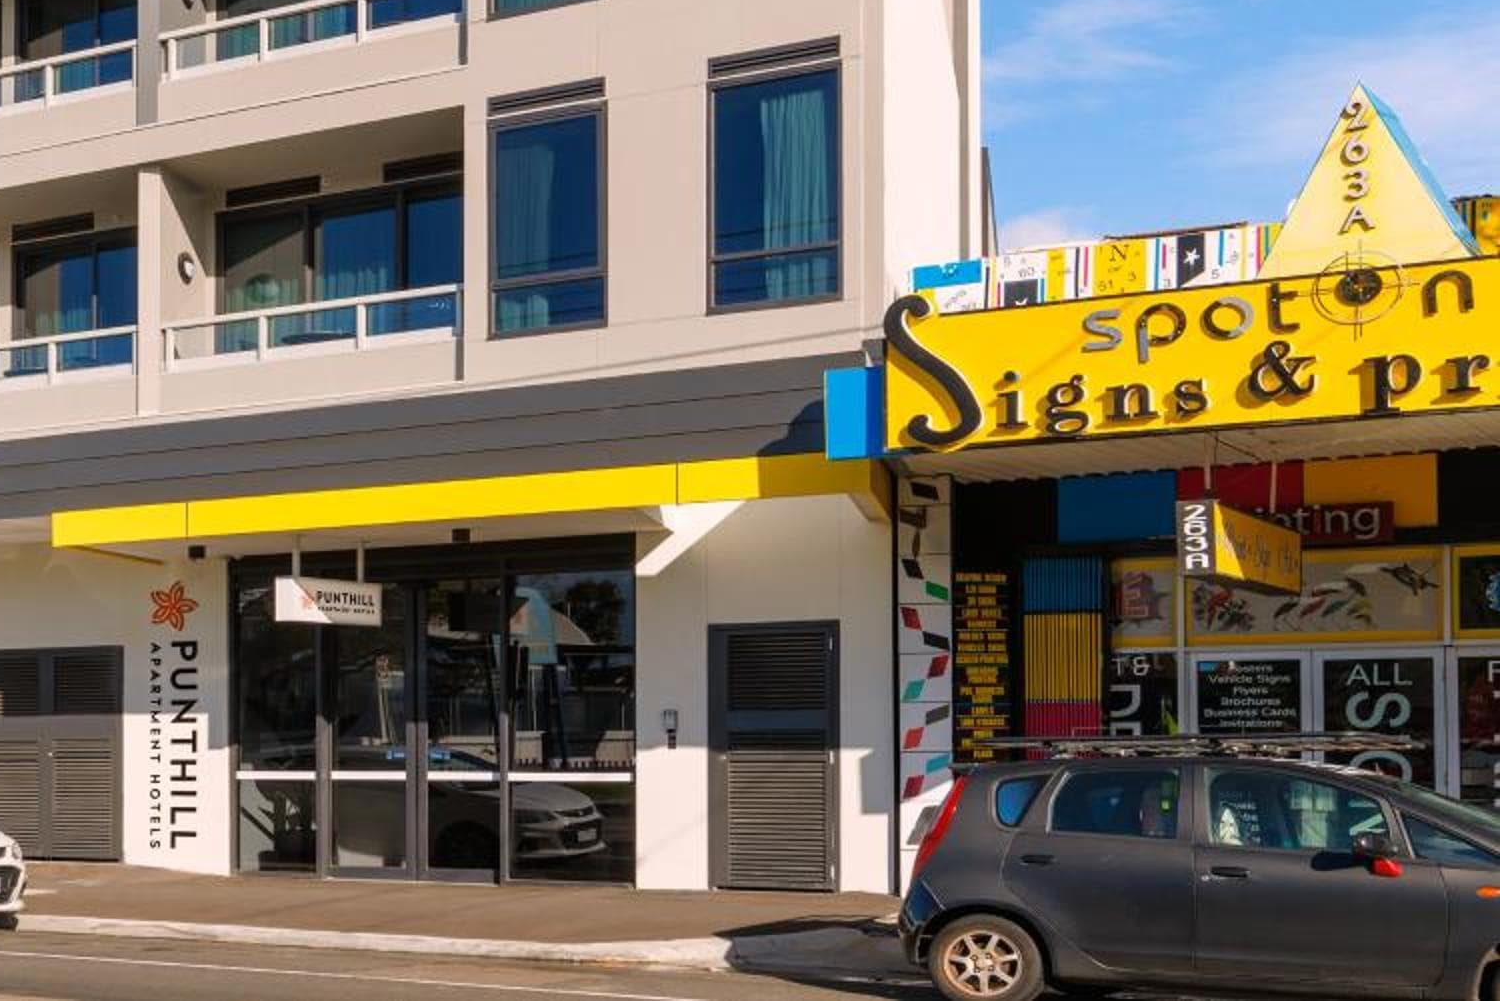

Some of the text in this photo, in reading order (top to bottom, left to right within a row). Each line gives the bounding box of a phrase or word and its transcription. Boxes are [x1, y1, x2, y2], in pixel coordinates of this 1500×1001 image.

[1340, 100, 1376, 235] 263A
[1082, 282, 1299, 363] spot
[884, 295, 1211, 446] Signs
[1249, 340, 1316, 398] &
[1183, 504, 1210, 570] 263A
[317, 590, 375, 607] PUNTHILL
[1209, 674, 1291, 685] Vehicle Signs
[1233, 686, 1268, 696] Flyers
[1345, 662, 1413, 686] ALL
[150, 642, 161, 848] APARTMENT HOTELS
[170, 640, 198, 849] PUNTHILL
[1261, 707, 1296, 717] Cards
